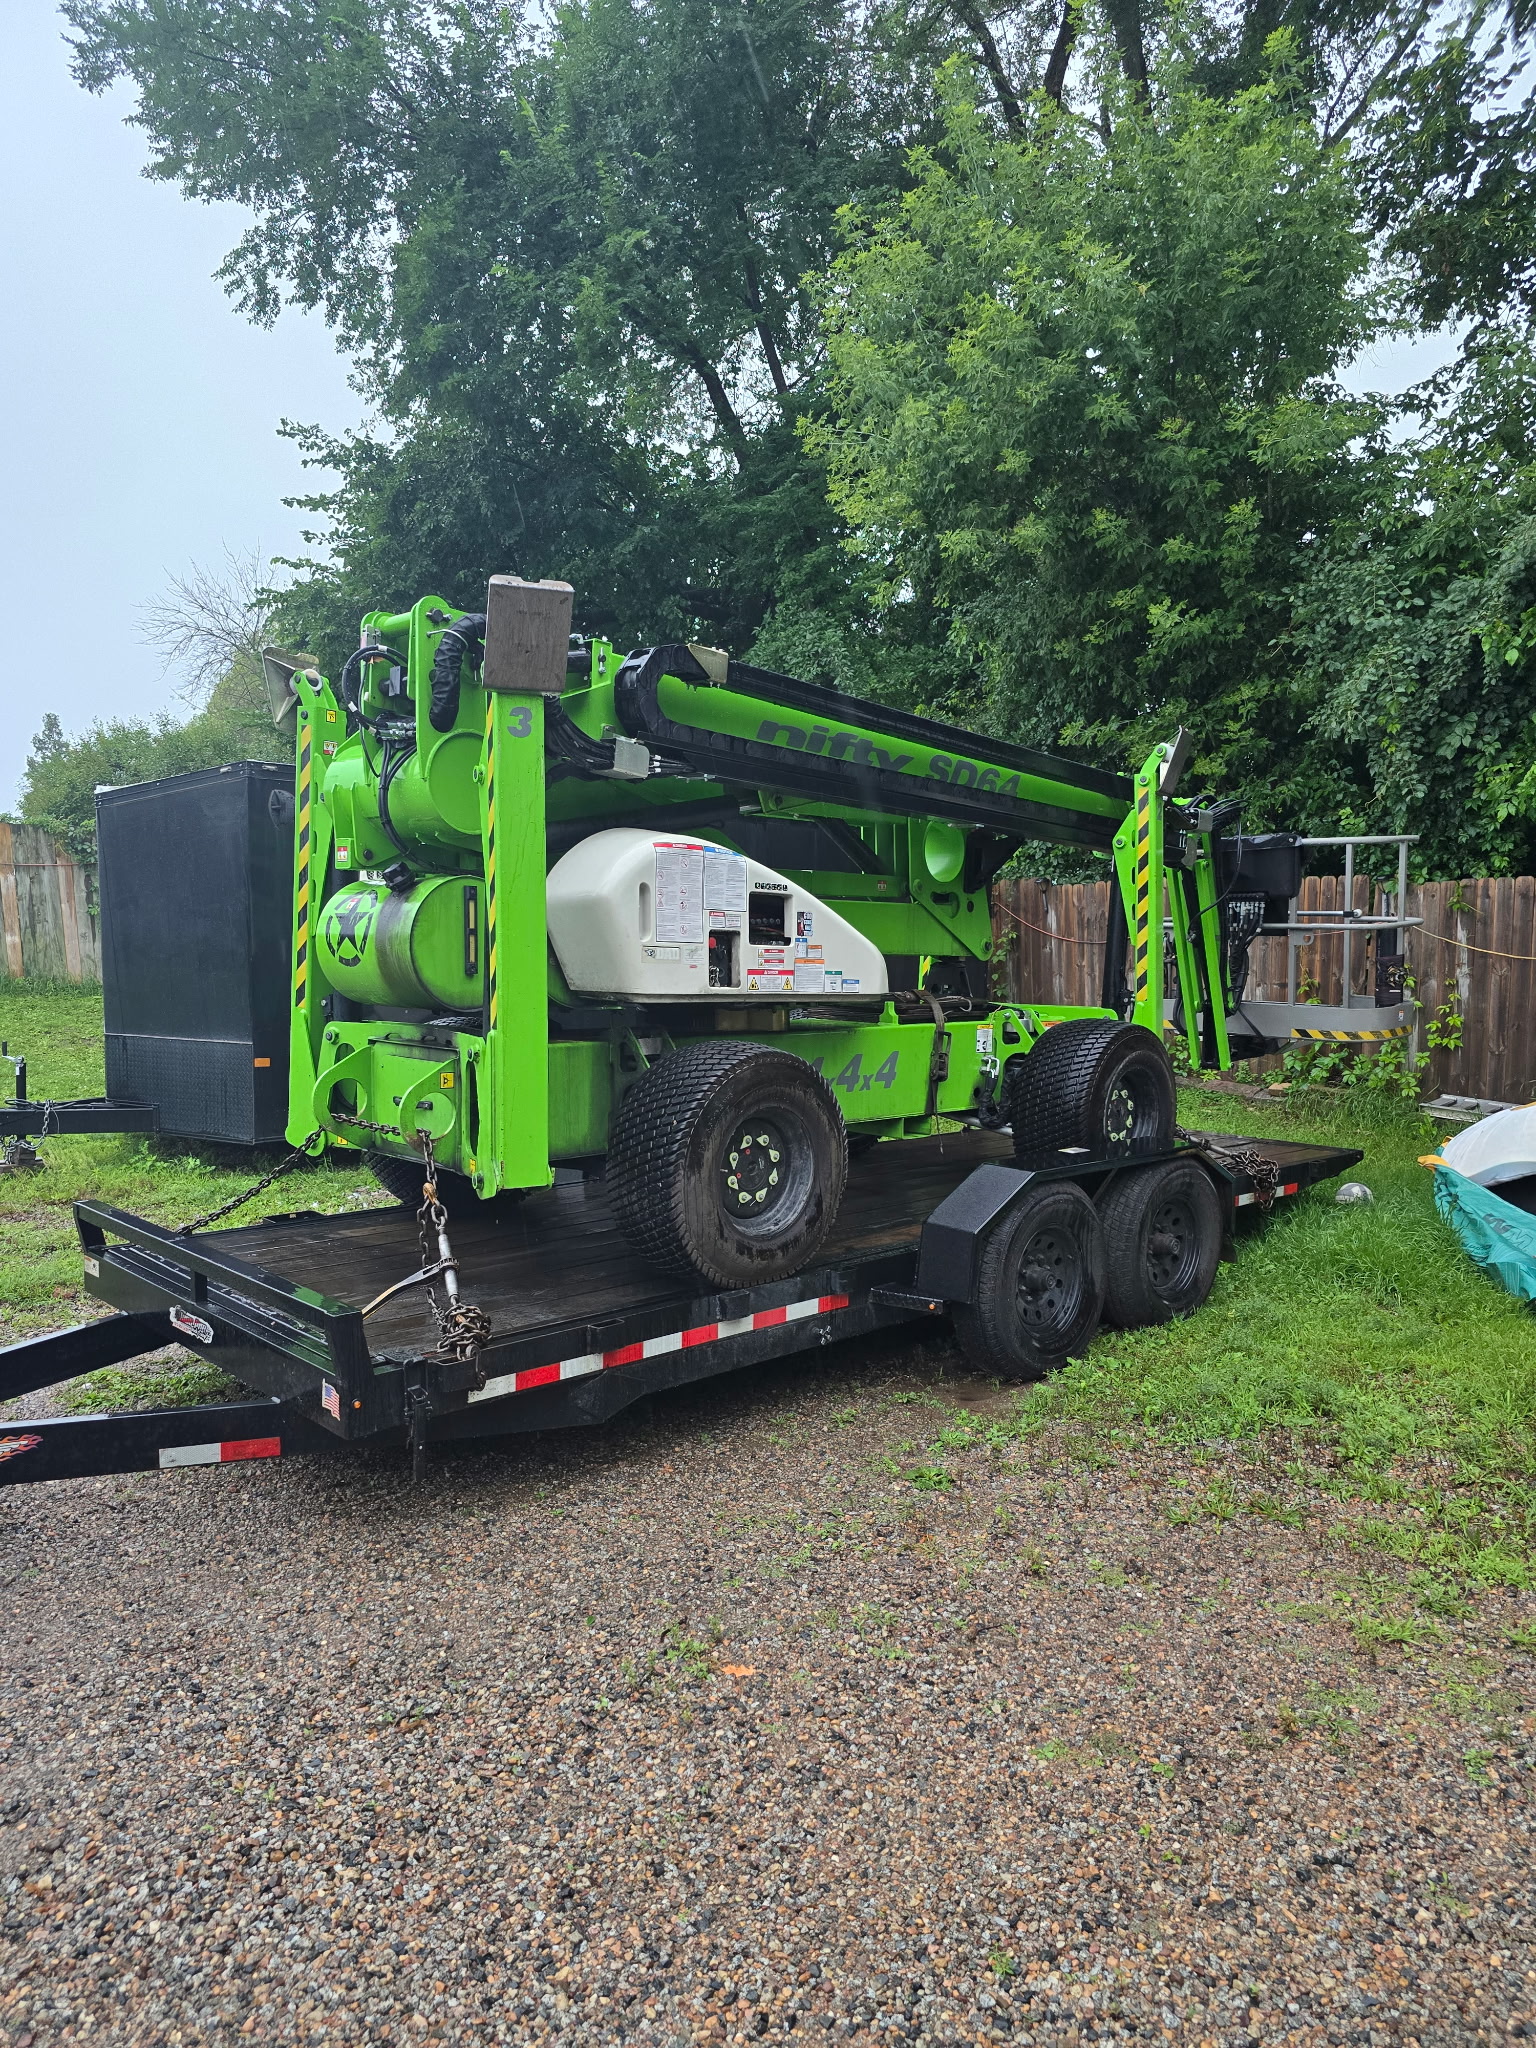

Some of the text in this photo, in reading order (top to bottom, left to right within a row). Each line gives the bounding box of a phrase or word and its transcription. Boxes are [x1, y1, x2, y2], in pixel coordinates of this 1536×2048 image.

[507, 706, 532, 738] 3
[756, 720, 1021, 797] nifty SD64
